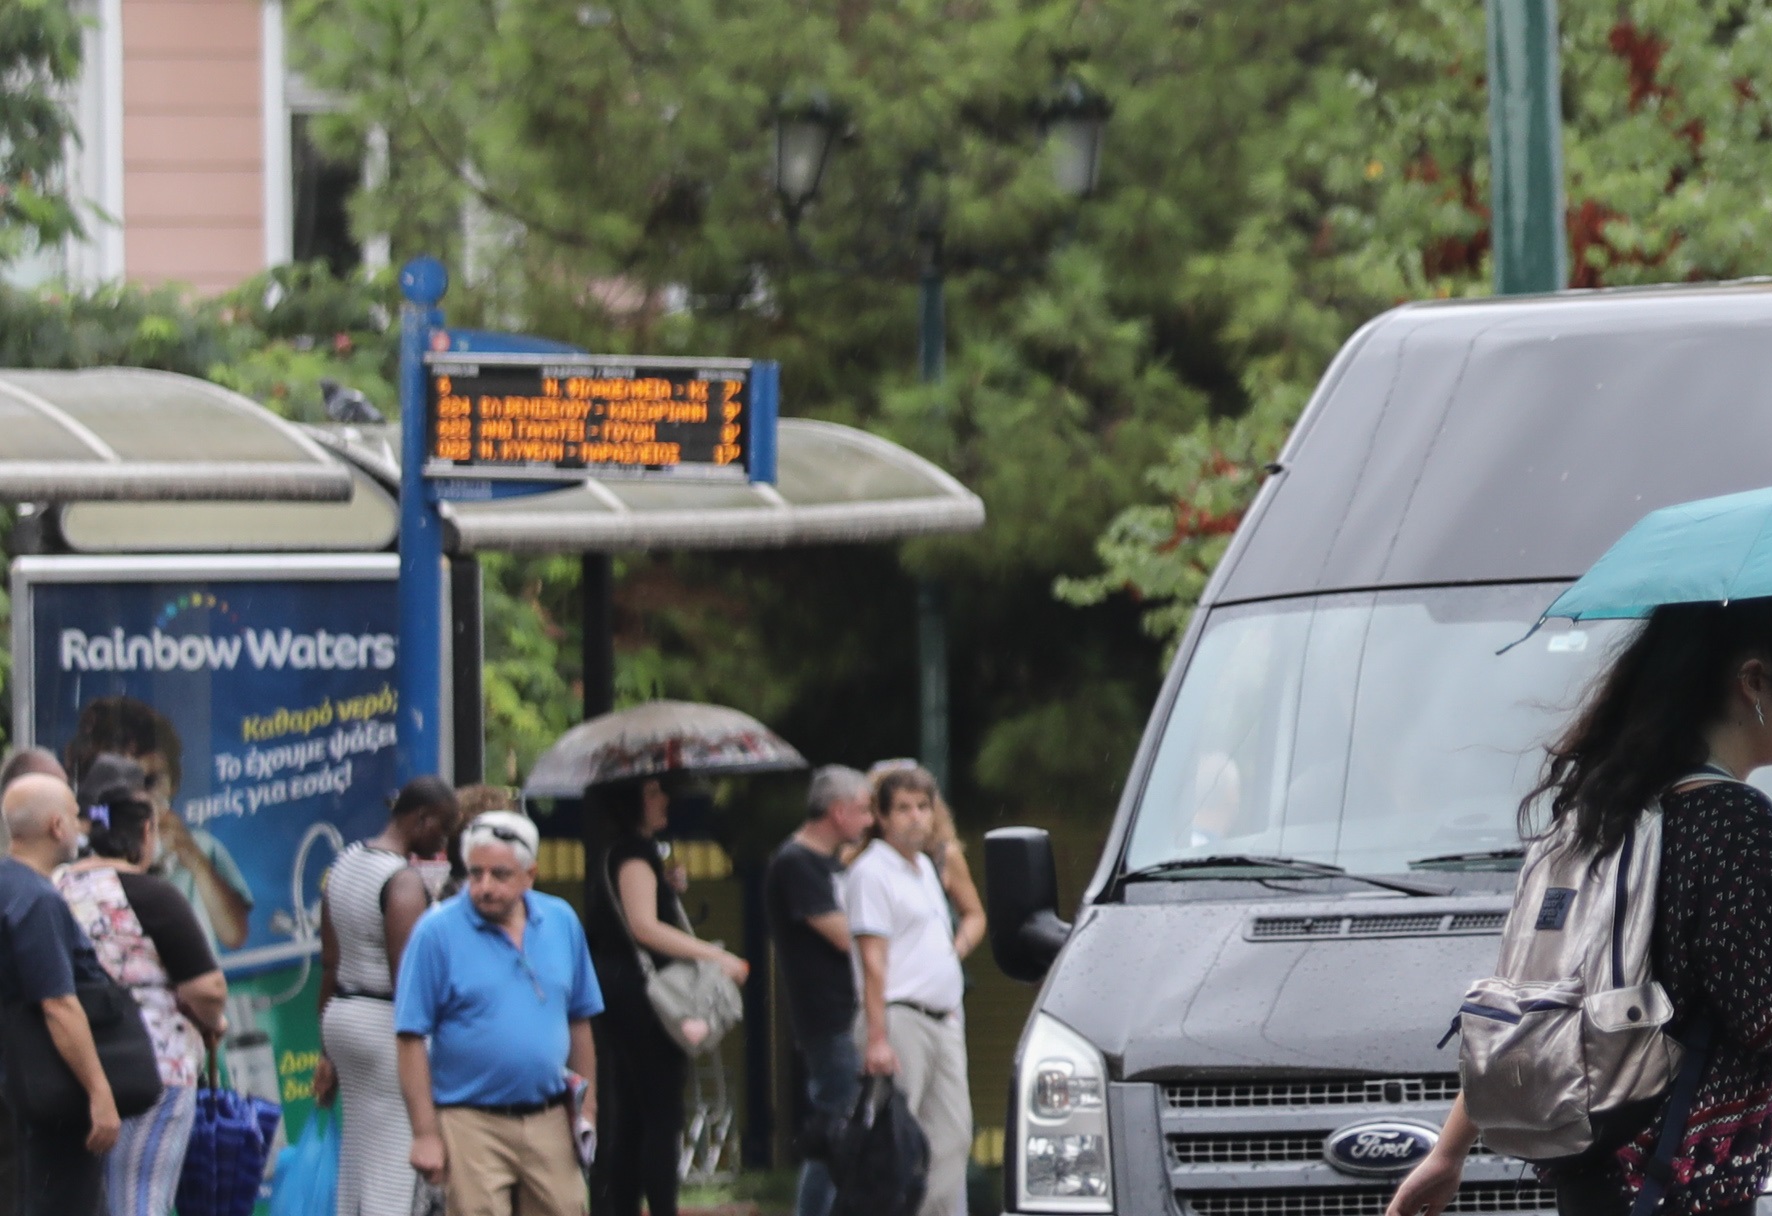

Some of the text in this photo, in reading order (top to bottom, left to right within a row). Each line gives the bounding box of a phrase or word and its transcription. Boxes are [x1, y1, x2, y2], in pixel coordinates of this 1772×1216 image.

[61, 626, 397, 672] Rainbow Waters
[242, 697, 334, 744] Καθαρό
[215, 752, 242, 783] Το
[245, 740, 327, 781] έχουμε
[185, 760, 353, 827] εμείς για εσάς!
[1350, 1129, 1416, 1159] Ford
